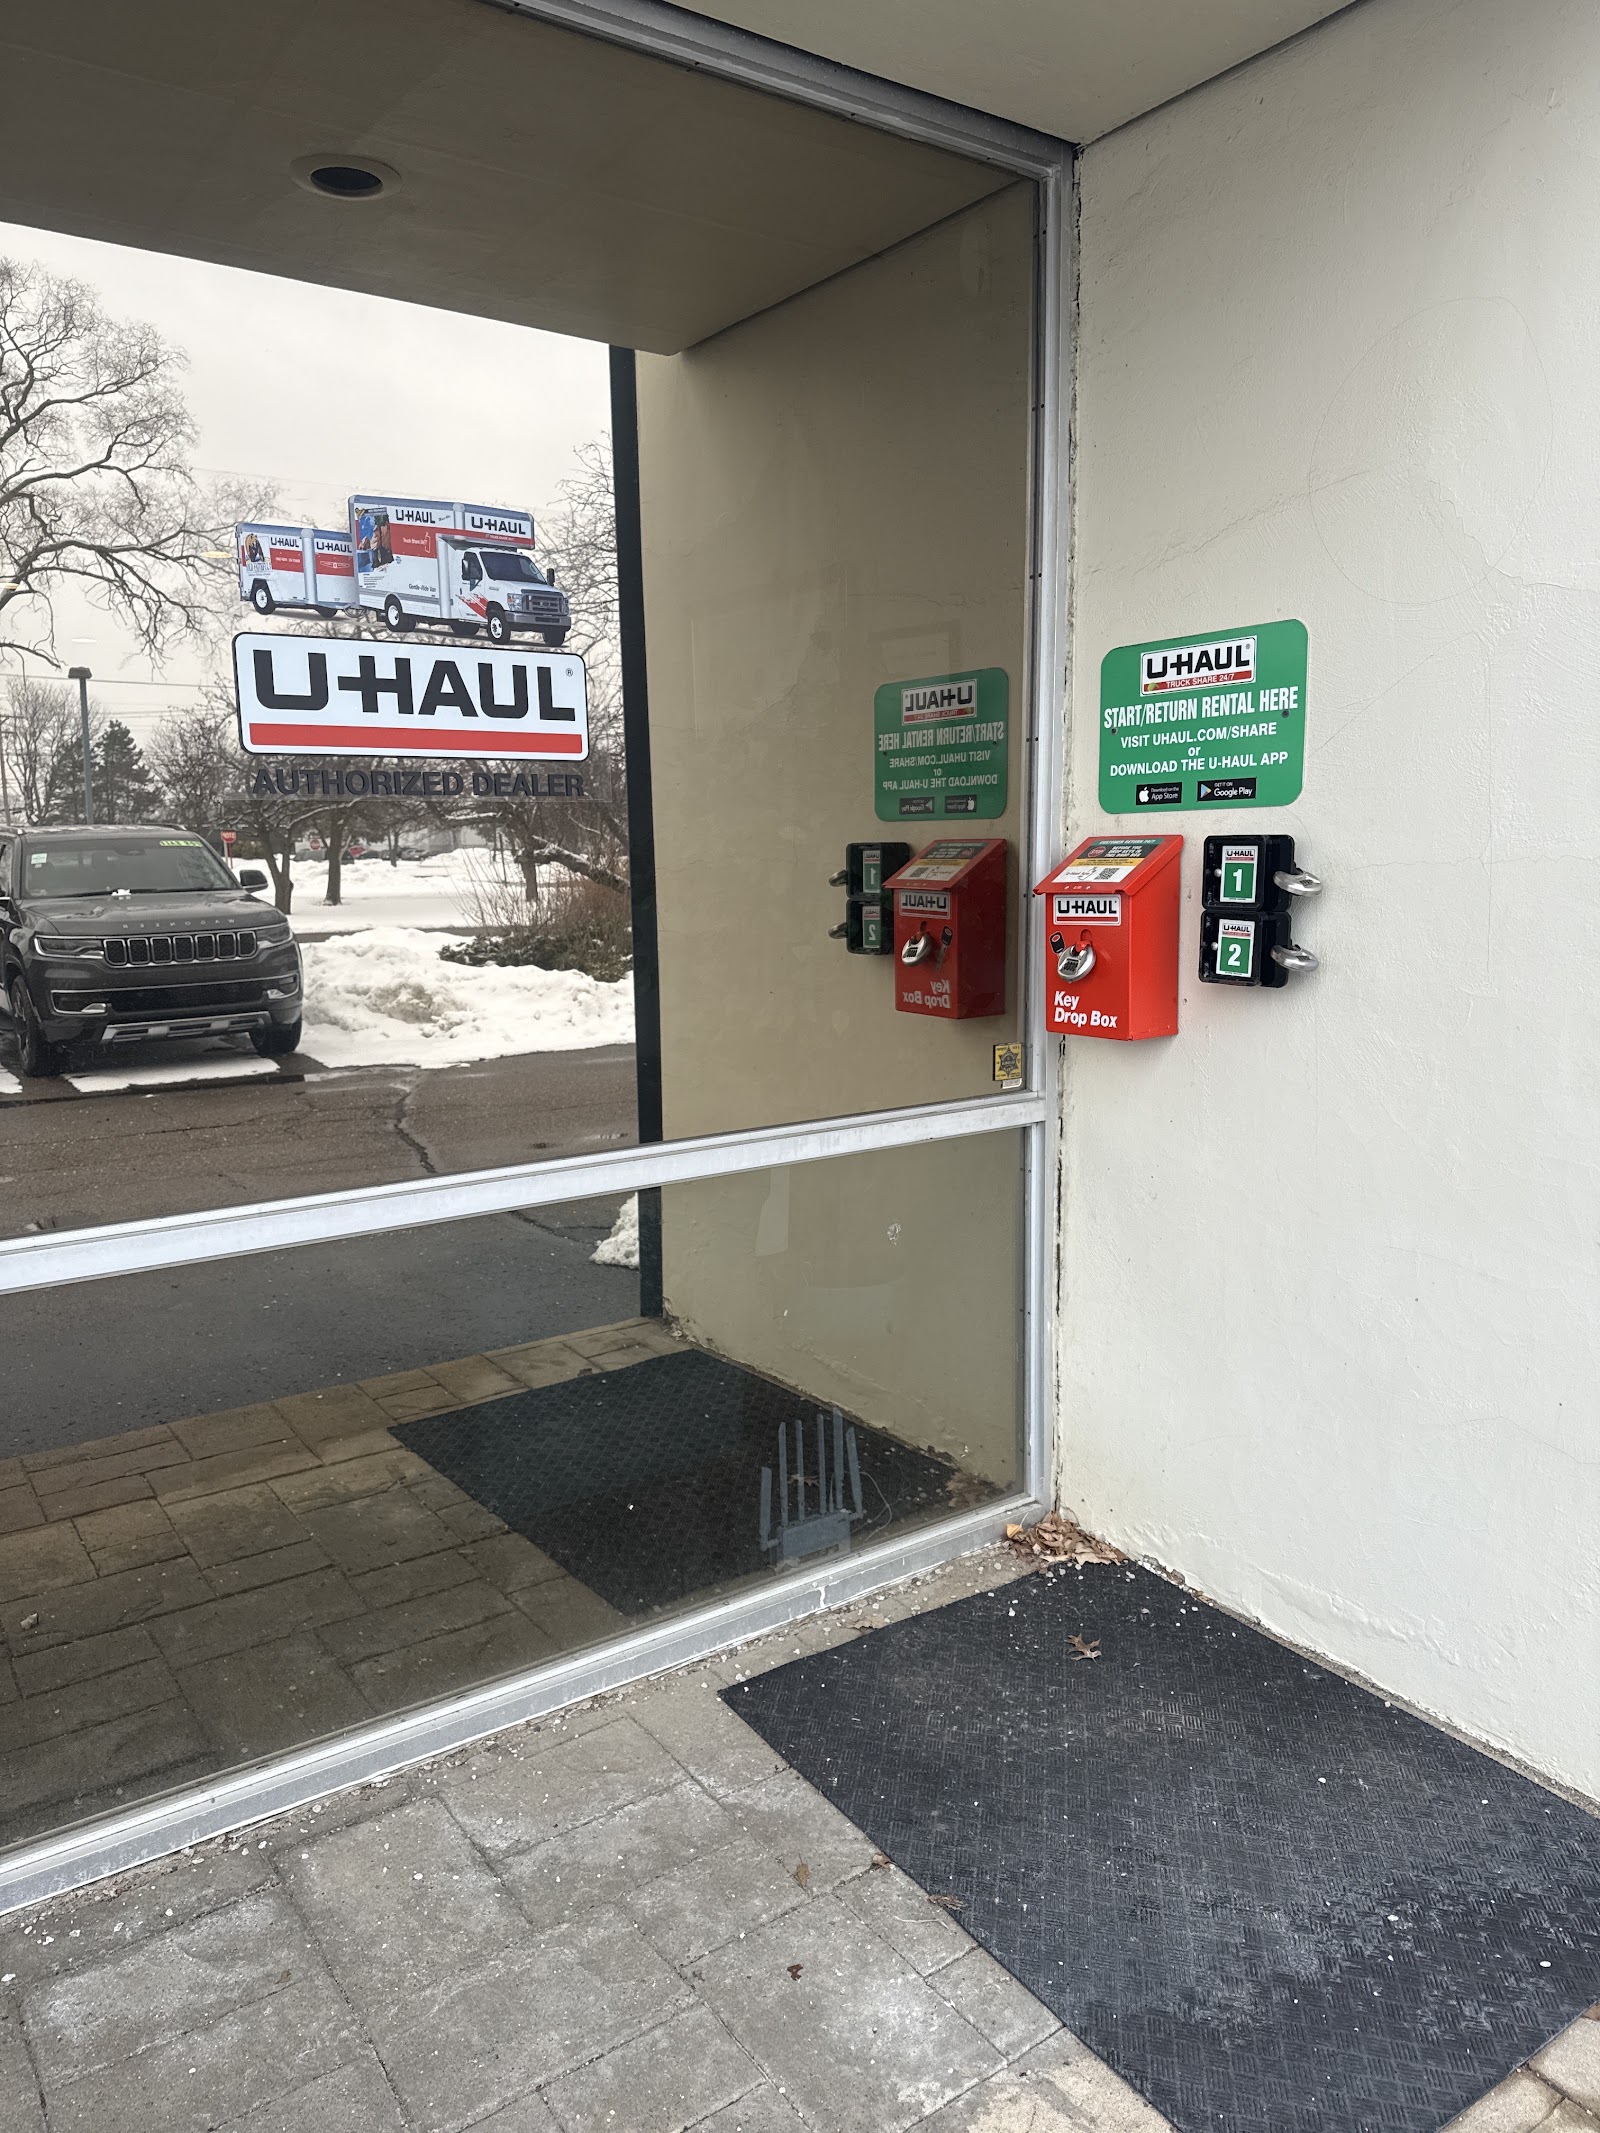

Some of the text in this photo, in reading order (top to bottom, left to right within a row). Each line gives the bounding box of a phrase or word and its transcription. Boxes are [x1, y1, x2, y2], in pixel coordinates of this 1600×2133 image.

[395, 509, 435, 524] U-HAUL
[471, 516, 526, 535] U-HAUL
[270, 537, 299, 548] U-HAUL
[316, 541, 352, 553] U-HAUL
[1147, 645, 1249, 679] U-HAUL
[253, 649, 576, 722] U-HAUL
[1166, 673, 1235, 688] TRUCK SHARE 24/7
[1104, 686, 1298, 729] START/RETURN RENTAL HERE
[1121, 722, 1277, 748] VISIT UHAUL.COM/SHARE
[1188, 746, 1201, 756] or
[1110, 751, 1288, 776] DOWNLOAD THE U-HAUL APP
[252, 769, 584, 797] AUTHORIZED DEALER
[1214, 786, 1253, 798] Google Play
[1233, 869, 1242, 892] 1
[1057, 900, 1117, 914] U-HAUL
[1223, 924, 1250, 932] U-HAUL
[1228, 943, 1241, 966] 2
[1054, 991, 1079, 1010] Key
[1054, 1007, 1118, 1028] Drop Box
